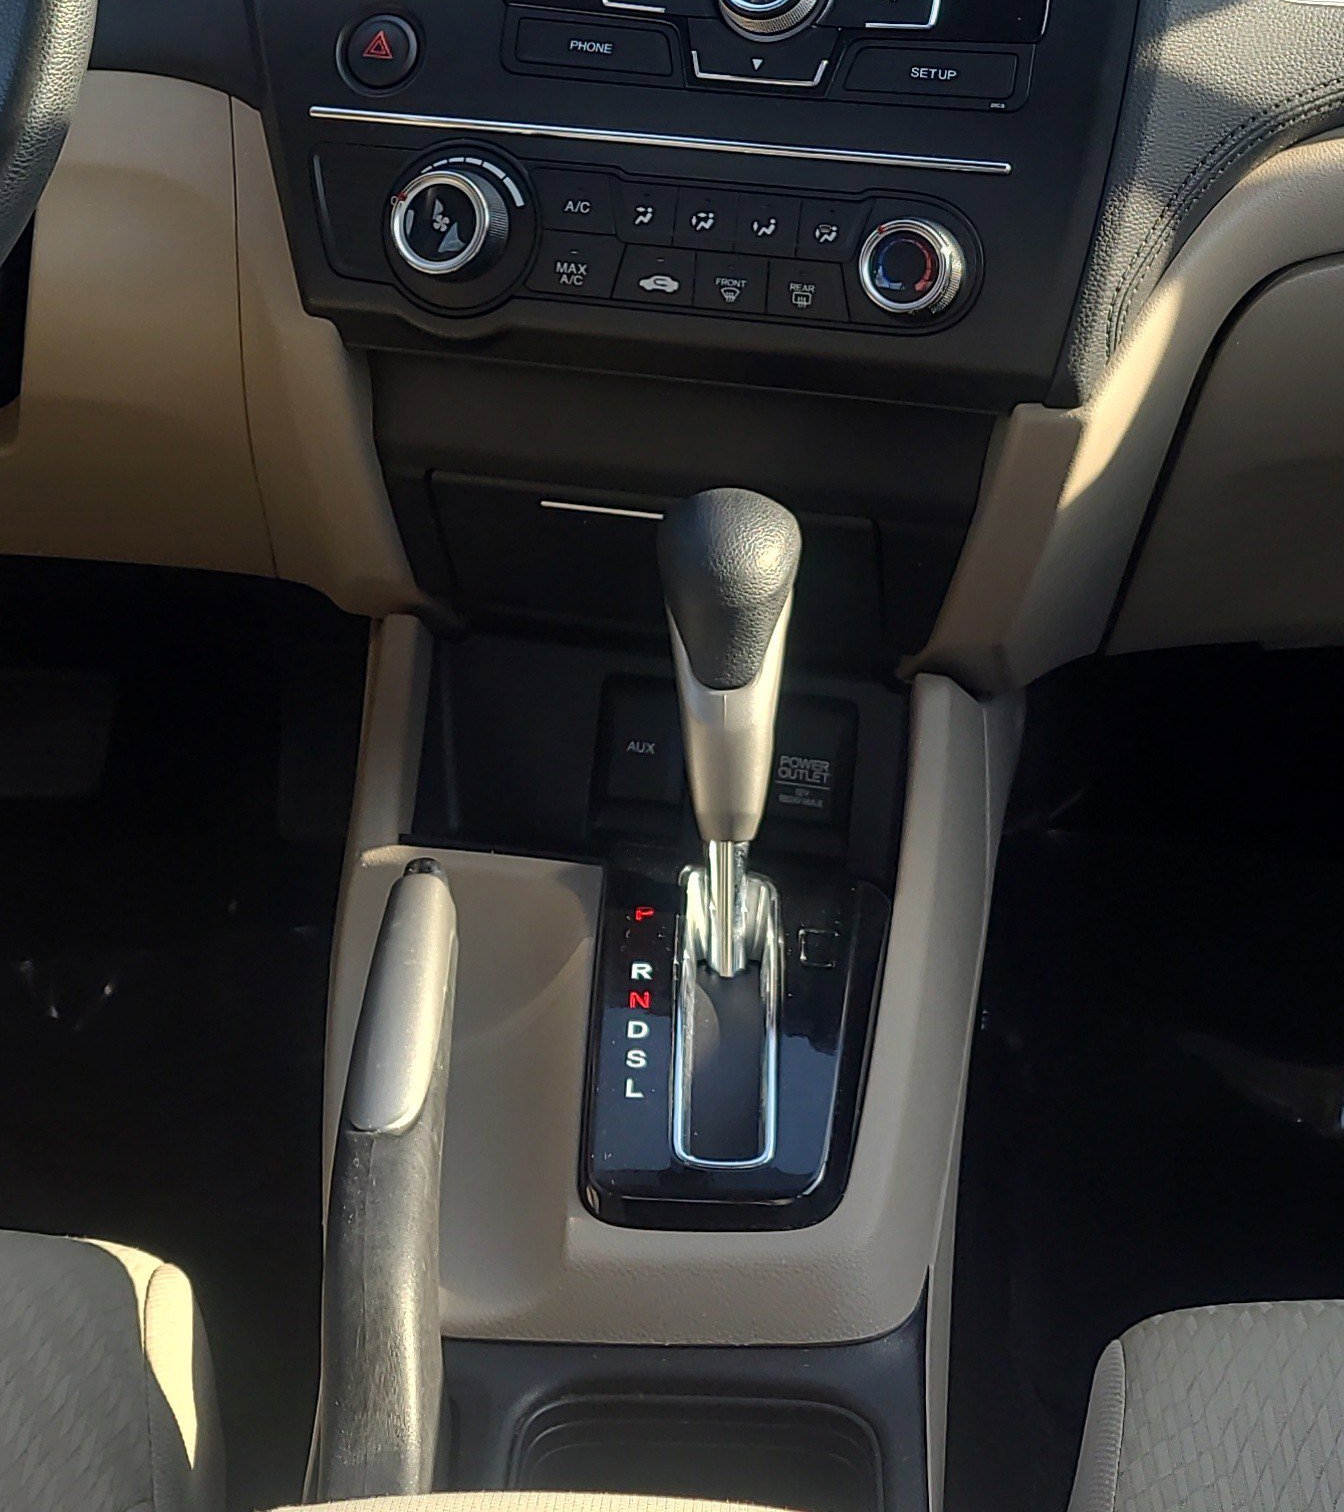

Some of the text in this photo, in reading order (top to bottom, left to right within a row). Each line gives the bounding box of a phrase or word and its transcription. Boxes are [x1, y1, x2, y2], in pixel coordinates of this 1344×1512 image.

[569, 39, 613, 54] PHONE
[564, 200, 591, 214] A/C
[556, 261, 588, 275] MAX
[559, 274, 583, 286] A/C
[715, 277, 747, 288] FRONT
[789, 282, 815, 292] REAR
[626, 740, 655, 754] AUX
[779, 755, 830, 774] POWER
[777, 766, 832, 784] OUTLET
[631, 963, 653, 980] R
[629, 991, 651, 1009] N
[627, 1020, 649, 1039] D
[626, 1049, 648, 1068] S
[625, 1077, 645, 1098] L
